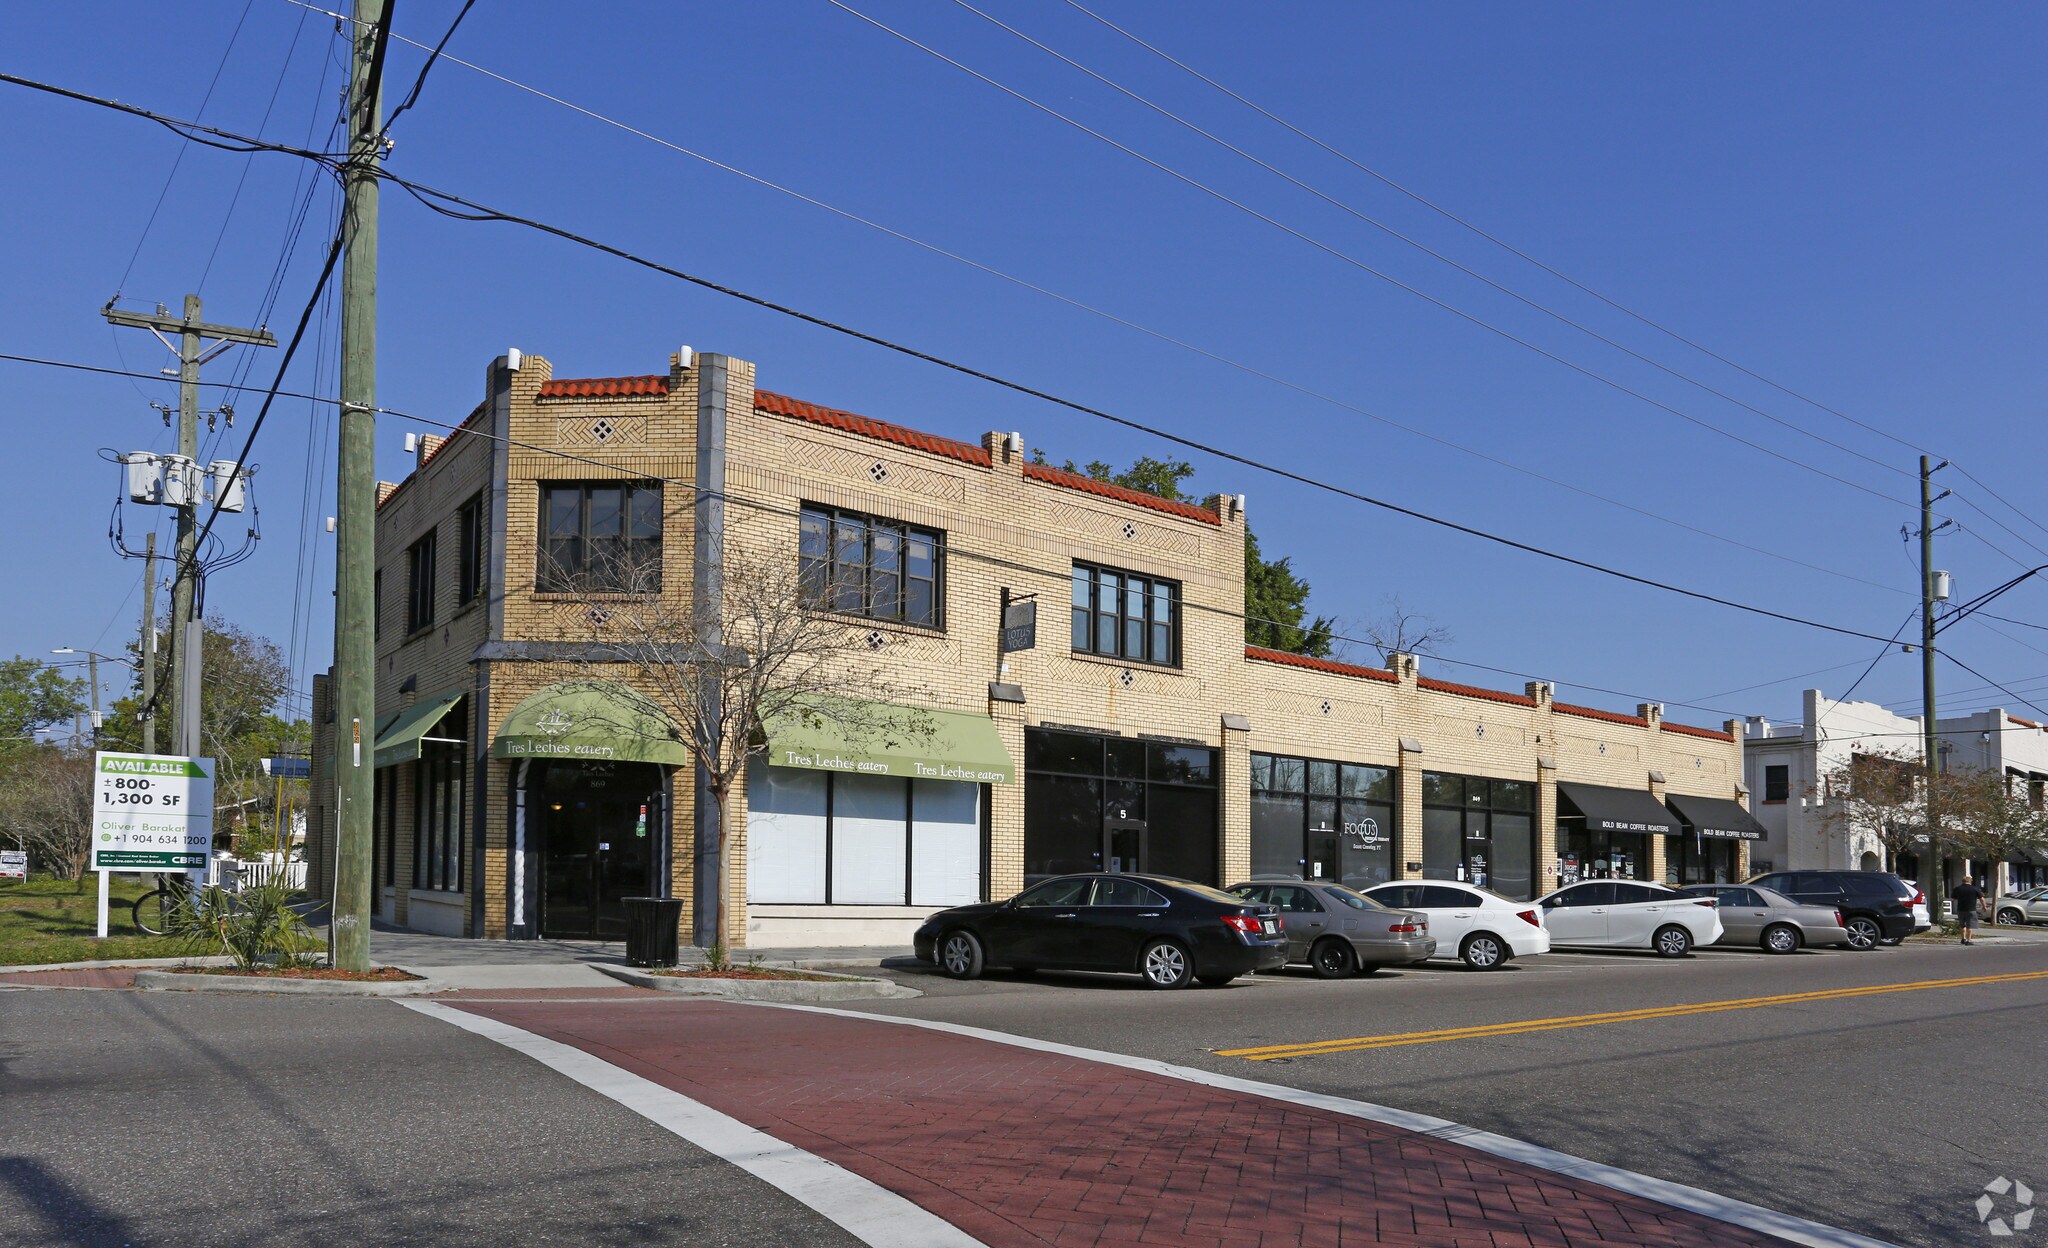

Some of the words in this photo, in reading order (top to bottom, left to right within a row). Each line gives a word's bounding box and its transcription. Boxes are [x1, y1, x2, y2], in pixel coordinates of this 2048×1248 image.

[1007, 628, 1031, 640] LOTUS
[1008, 637, 1028, 649] YOGA
[506, 741, 525, 754] Tres
[528, 740, 571, 754] Leches
[574, 745, 614, 758] eatery
[104, 760, 184, 774] AVAILABLE
[785, 751, 812, 765] Tres
[816, 754, 855, 769] Leches
[857, 761, 889, 774] eatery
[914, 762, 937, 776] Tres
[940, 764, 975, 779] Leches
[977, 771, 1005, 782] eatery
[590, 780, 606, 788] 869
[104, 792, 153, 806] 1,300
[162, 795, 181, 806] SF
[1120, 809, 1127, 819] 5
[101, 821, 136, 831] Oliver
[142, 823, 186, 833] Barakat
[1344, 822, 1376, 836] FOCUS
[1602, 821, 1614, 829] BOLD
[1630, 823, 1646, 831] COFFEE
[113, 833, 127, 843] +1
[132, 834, 153, 844] 904
[158, 835, 178, 844] 634
[183, 836, 207, 845] 1200
[1703, 828, 1714, 836] BOLD
[1726, 830, 1740, 838] COFFEE
[171, 856, 203, 865] CBRE
